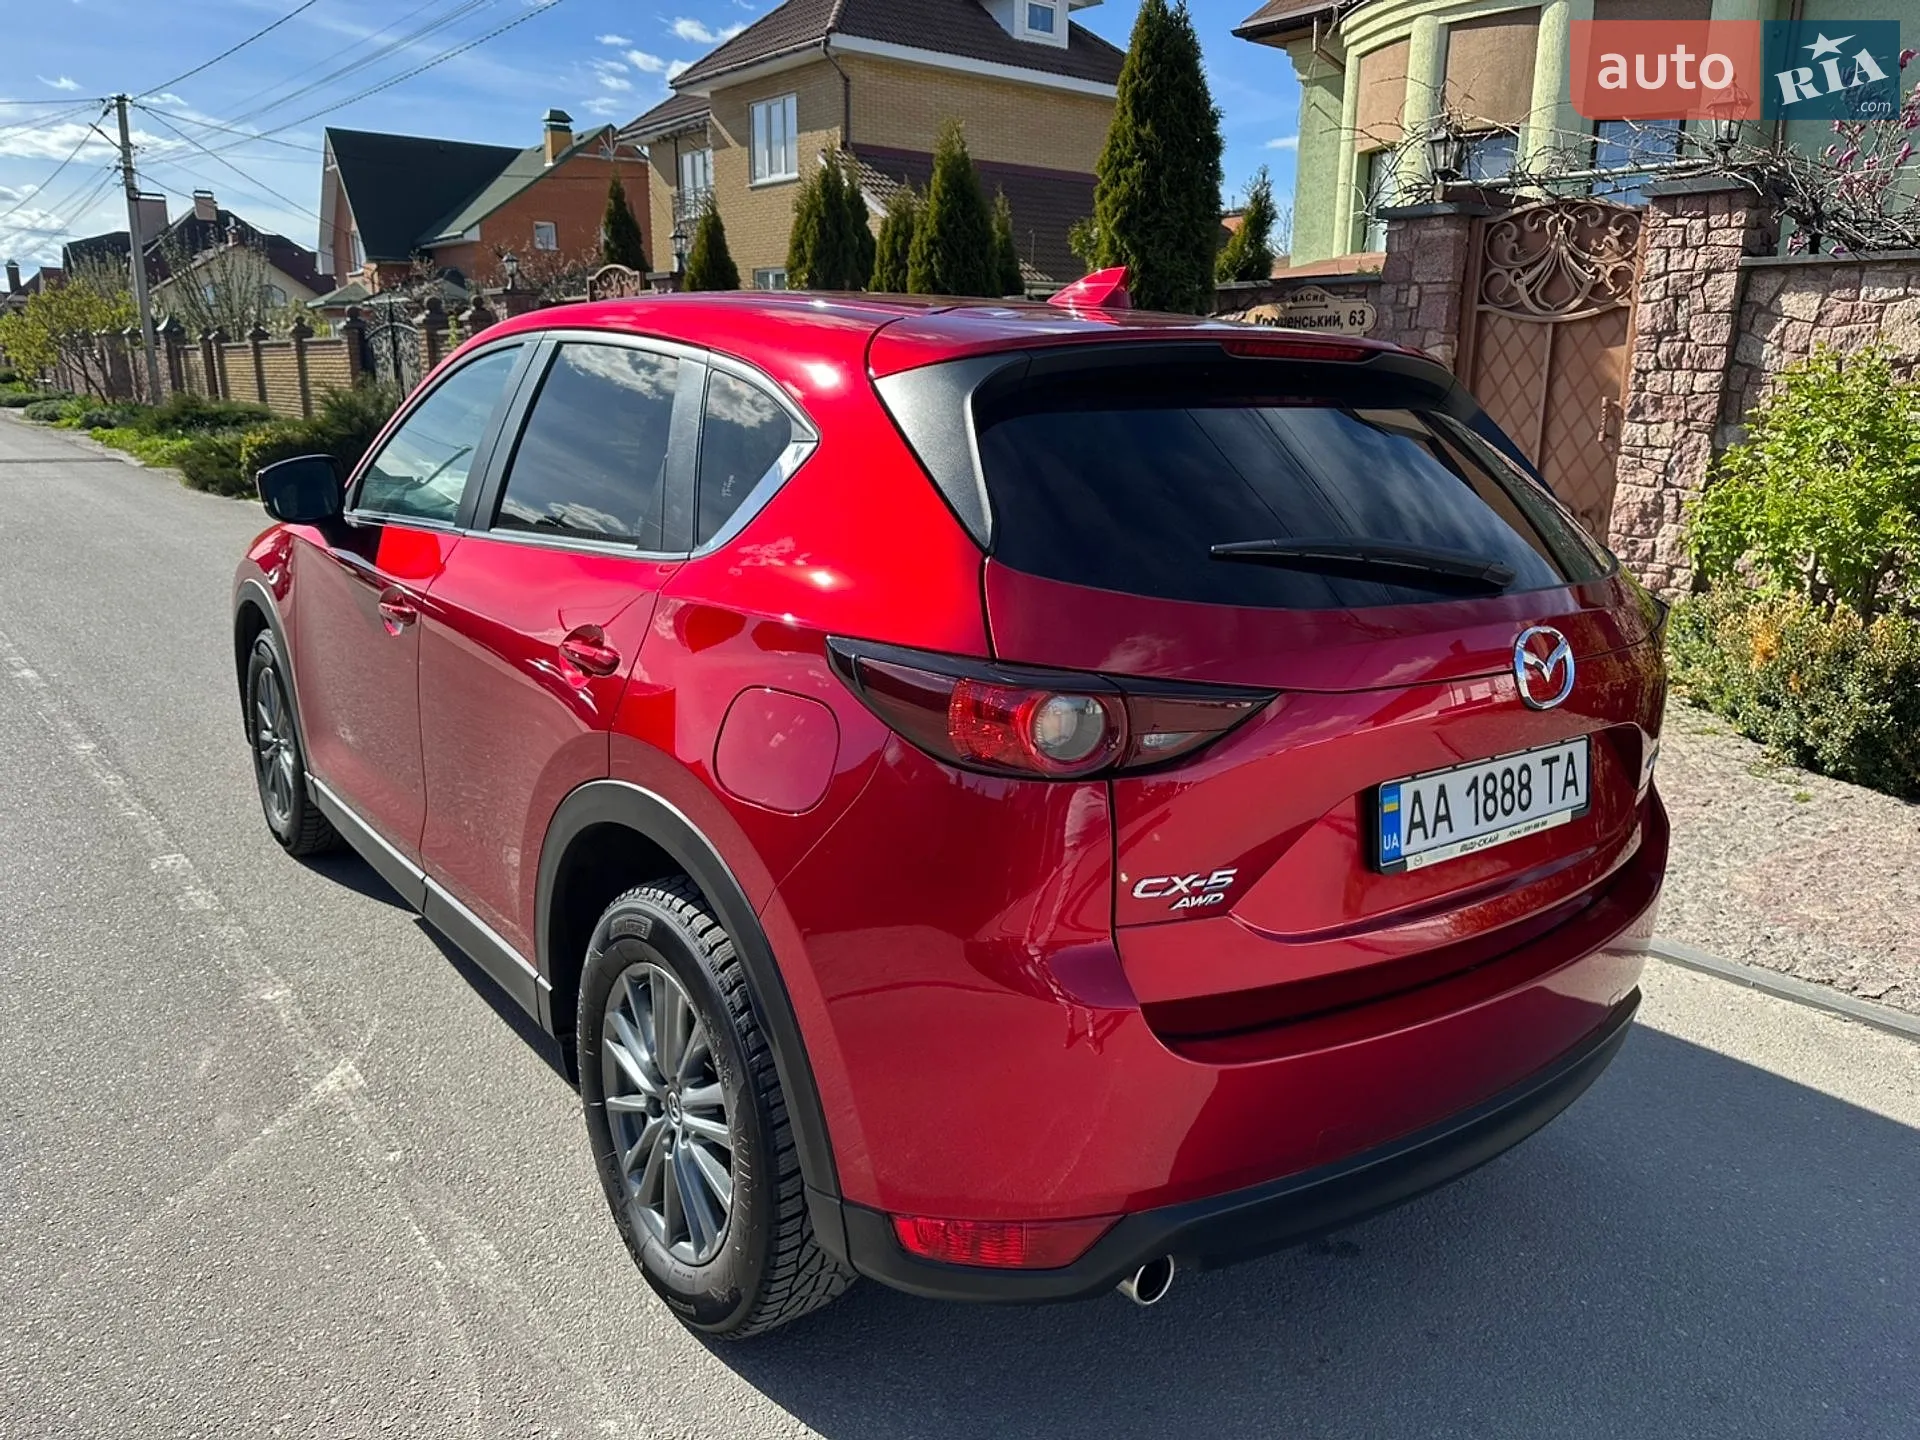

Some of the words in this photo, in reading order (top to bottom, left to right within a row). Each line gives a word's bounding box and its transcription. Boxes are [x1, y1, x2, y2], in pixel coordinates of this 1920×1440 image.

[1348, 309, 1366, 326] 63
[1405, 783, 1454, 845] AA
[1466, 763, 1532, 826] 1888
[1541, 751, 1580, 804] TA
[1383, 832, 1400, 850] UA
[1132, 868, 1238, 898] CX-5
[1169, 892, 1225, 911] AWD
